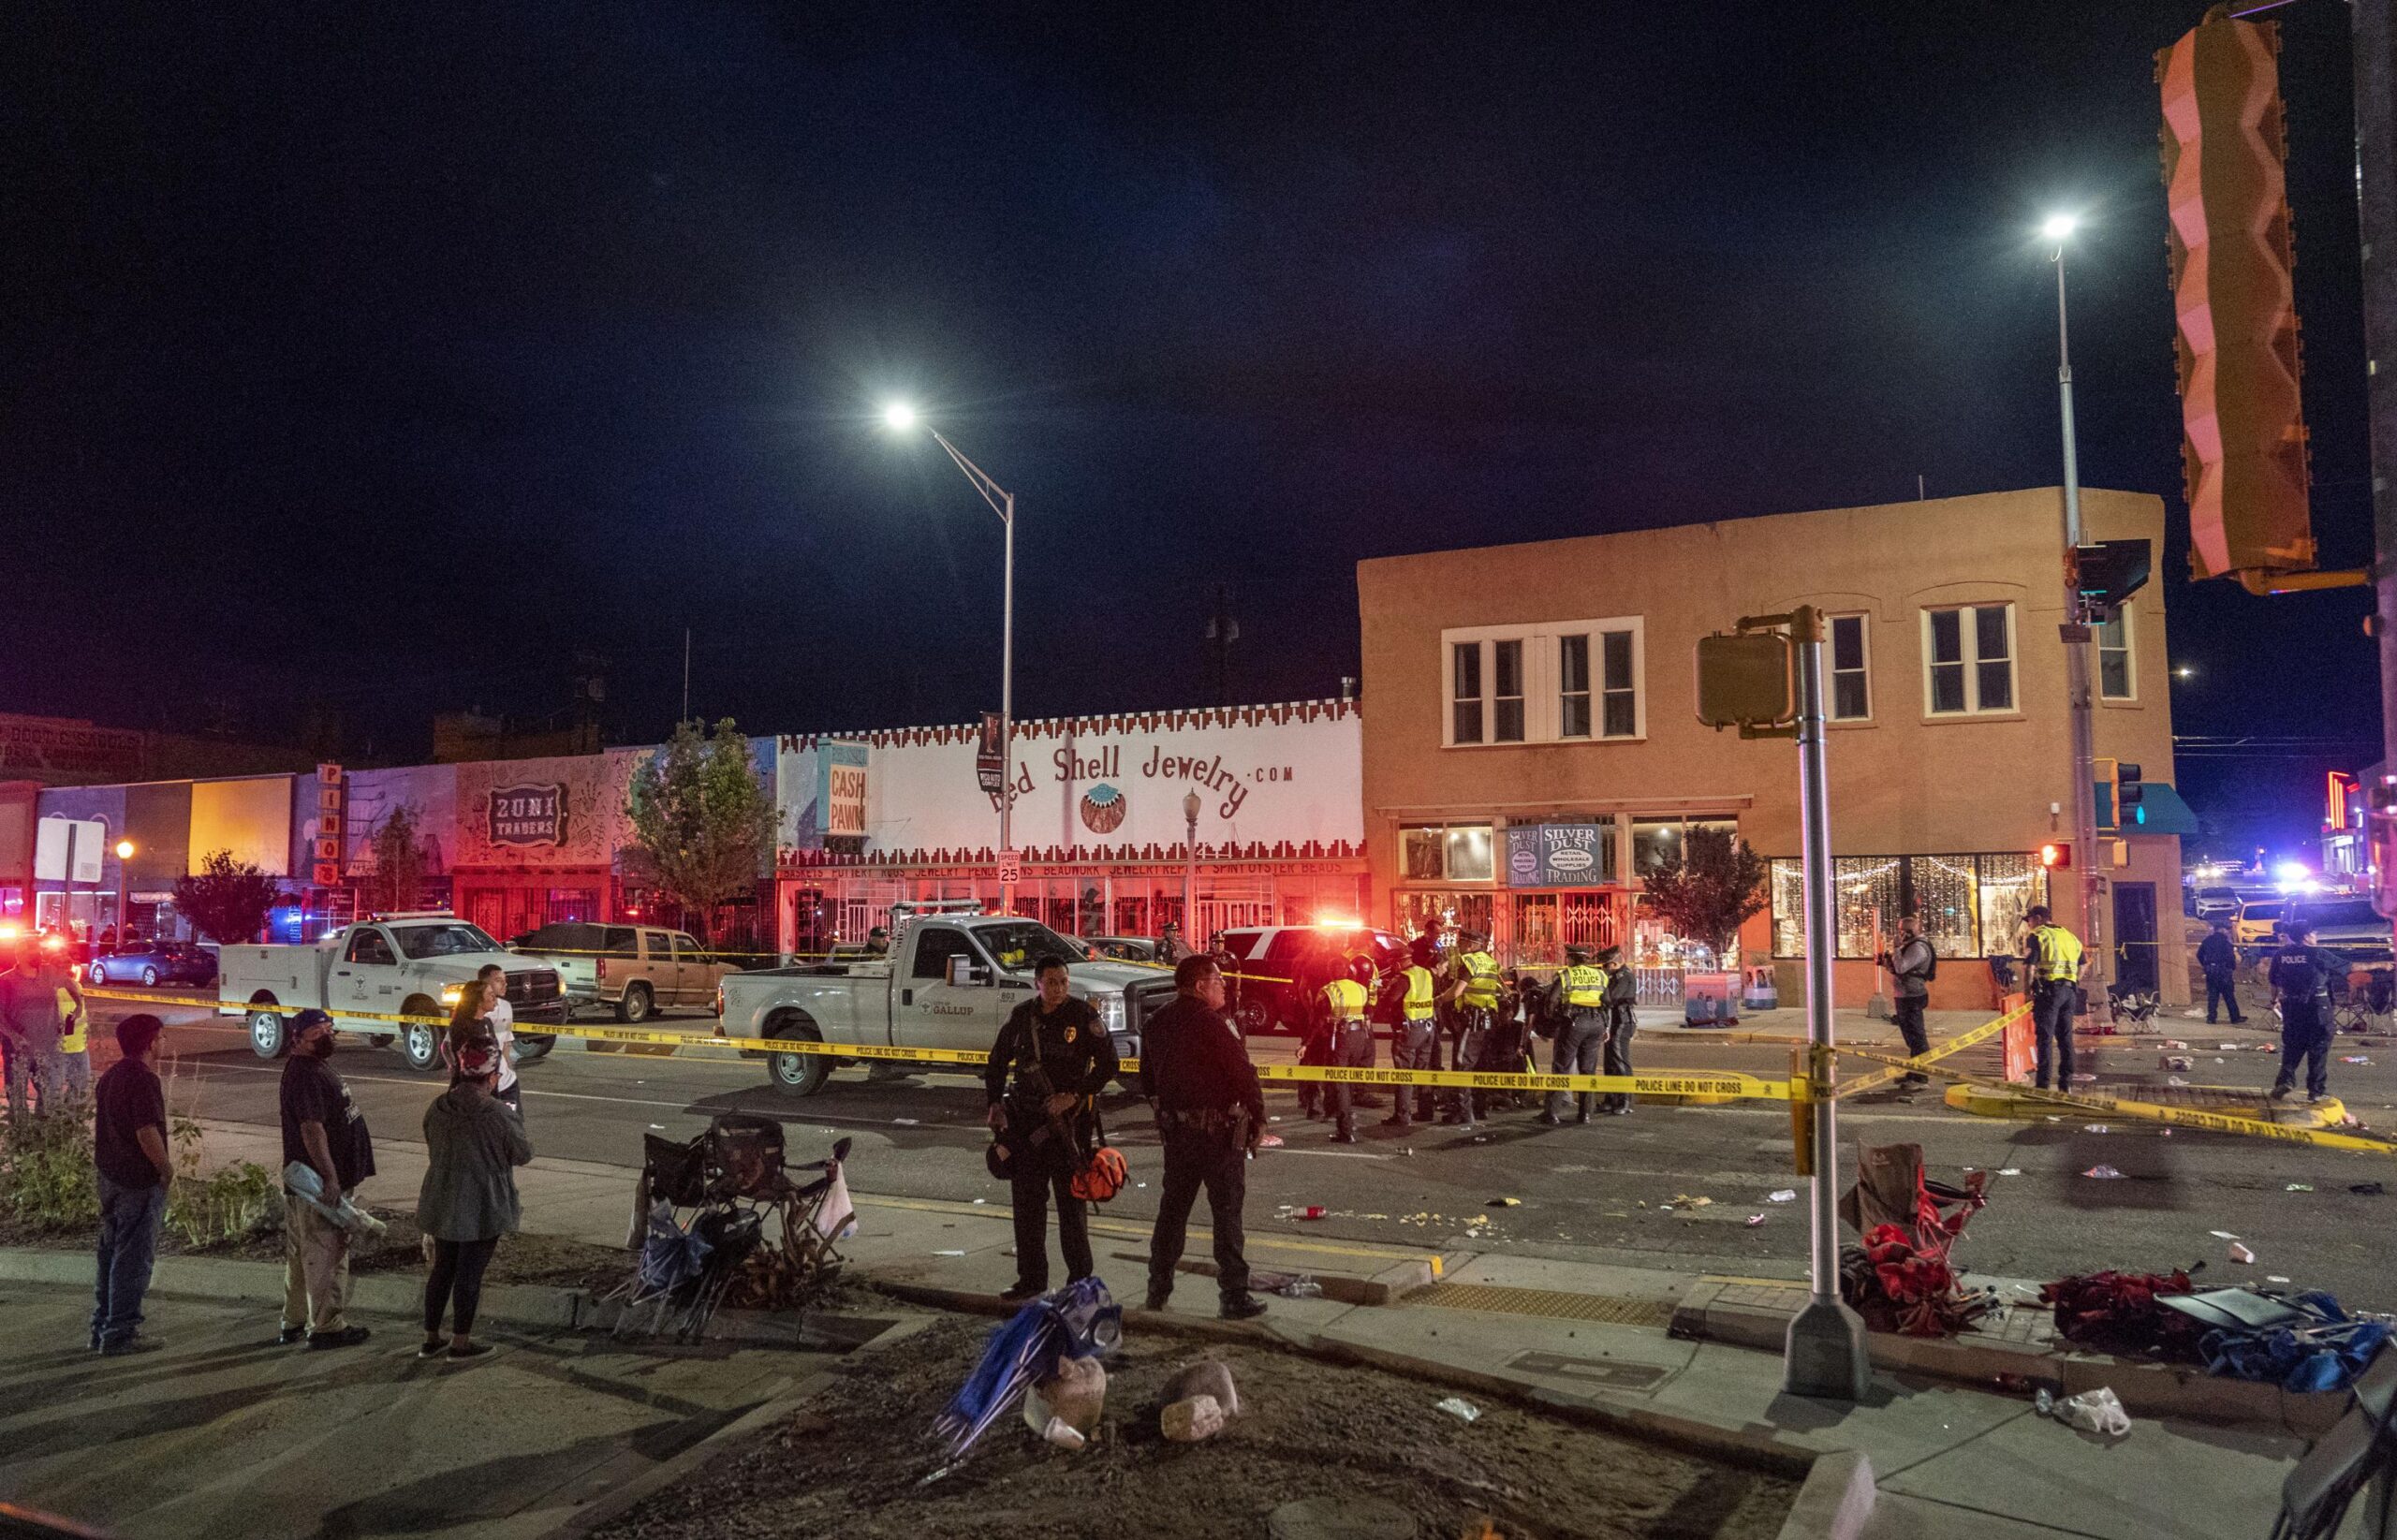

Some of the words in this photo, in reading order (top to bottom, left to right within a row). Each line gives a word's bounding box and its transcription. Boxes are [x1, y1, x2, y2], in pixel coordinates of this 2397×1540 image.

[831, 770, 866, 799] CASH
[1052, 745, 1120, 782] Shell
[1141, 745, 1249, 819] Jewelry
[496, 798, 555, 818] ZUNI
[831, 804, 866, 831] PAWN
[496, 821, 553, 836] TRADERS
[1509, 830, 1537, 843] SILVER
[1544, 829, 1596, 842] SILVER
[1512, 842, 1536, 853] DUST
[1550, 839, 1592, 852] DUST
[784, 869, 824, 878] BASKETS
[915, 867, 959, 877] JEWELRY
[1043, 866, 1100, 876] BEADWORK
[1109, 865, 1158, 875] JEWELRY
[1301, 863, 1343, 873] BEADS
[1000, 868, 1019, 882] 25
[1546, 869, 1597, 883] TRADING
[2281, 955, 2308, 964] POLICE
[1573, 975, 1599, 985] POLICE
[933, 1005, 975, 1016] GALLUP
[1409, 1001, 1433, 1009] POLICE
[764, 1041, 779, 1049] POLICE
[856, 1047, 873, 1055] POLICE
[873, 1048, 883, 1056] LINE
[957, 1052, 975, 1062] POLICE
[975, 1053, 987, 1063] LINE
[1325, 1069, 1348, 1079] POLICE
[1348, 1070, 1364, 1080] LINE
[1364, 1070, 1375, 1080] DO
[1375, 1071, 1390, 1081] NOT
[1390, 1072, 1413, 1082] CROSS
[1473, 1075, 1499, 1086] POLICE
[1499, 1076, 1516, 1087] LINE
[1517, 1076, 1528, 1087] DO
[1529, 1076, 1544, 1087] NOT
[1545, 1077, 1570, 1088] CROSS
[1635, 1079, 1663, 1092] POLICE
[1665, 1080, 1683, 1093] LINE
[1684, 1081, 1696, 1093] DO
[1697, 1081, 1713, 1093] NOT
[1714, 1082, 1742, 1094] CROSS
